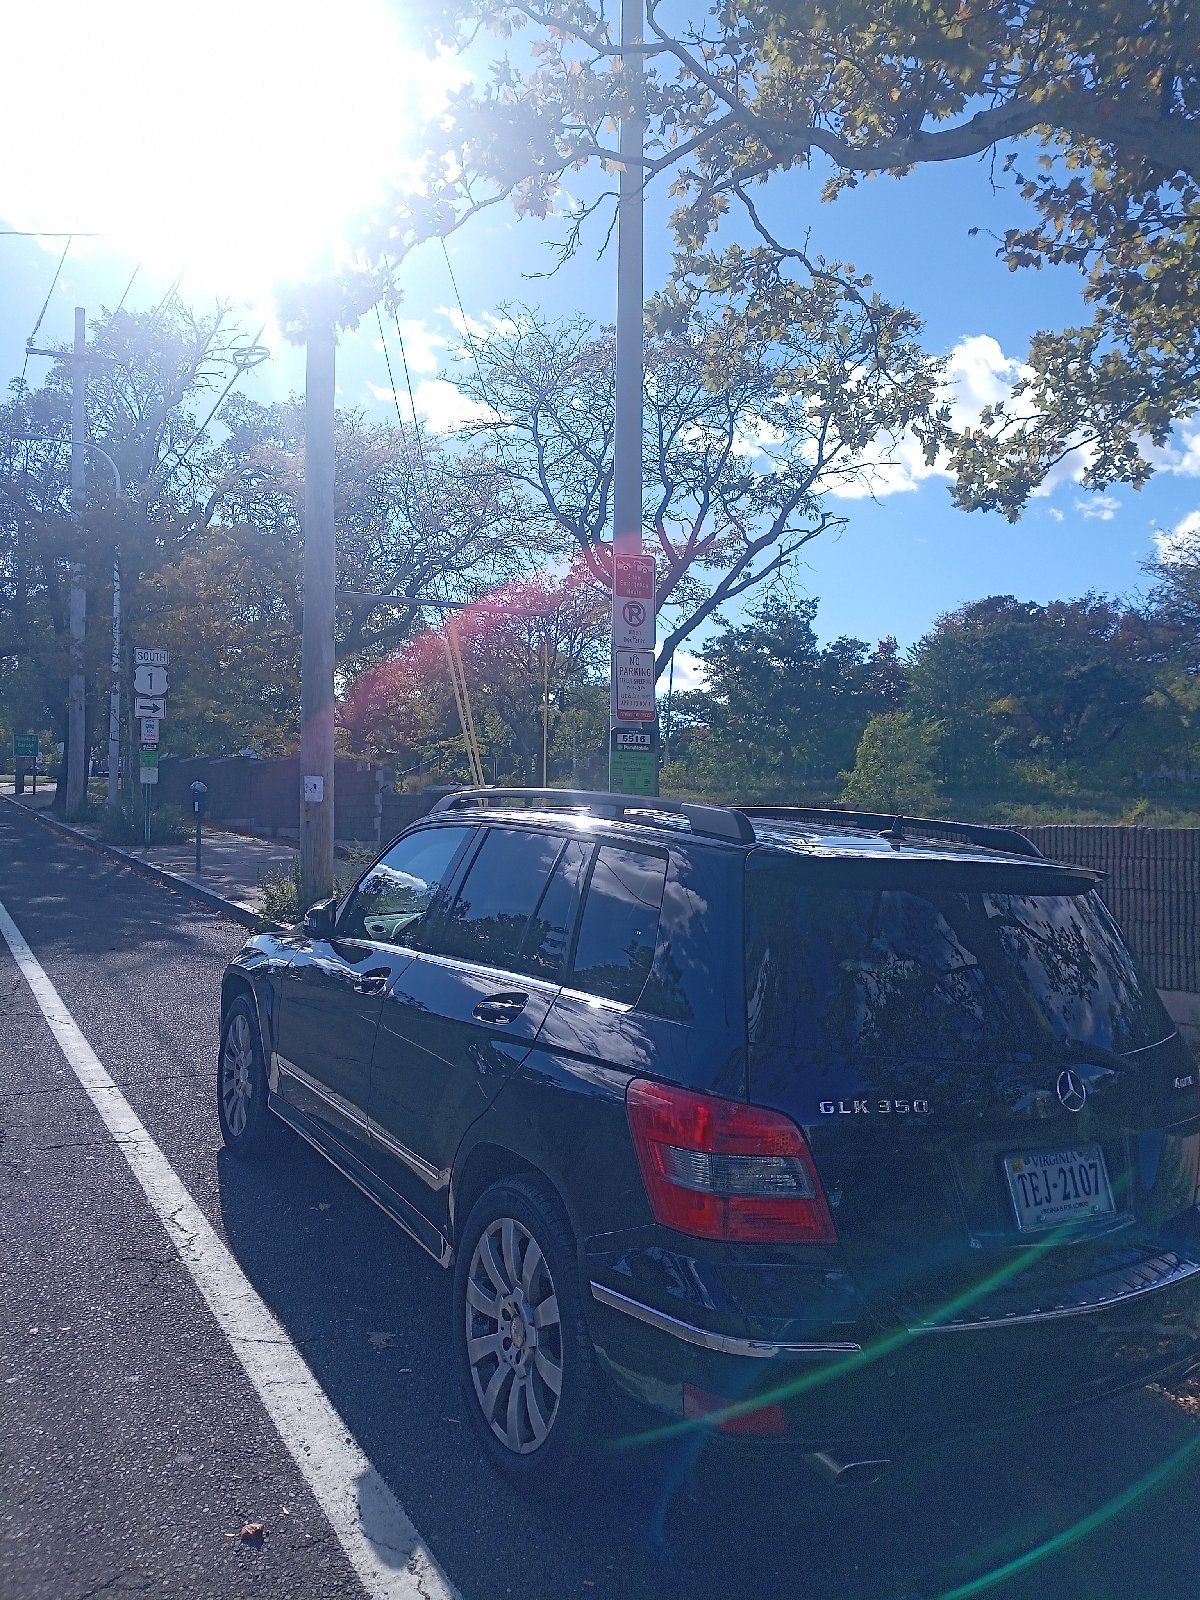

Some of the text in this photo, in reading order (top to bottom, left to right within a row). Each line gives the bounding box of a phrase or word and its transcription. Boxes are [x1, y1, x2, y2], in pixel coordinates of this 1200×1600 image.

[137, 651, 166, 662] SOUTH
[629, 656, 640, 666] NO
[620, 667, 651, 677] PARKING
[147, 672, 153, 690] 1
[622, 735, 646, 743] 5516
[819, 1099, 928, 1114] GLK 350
[1032, 1151, 1078, 1167] VIRGINIA
